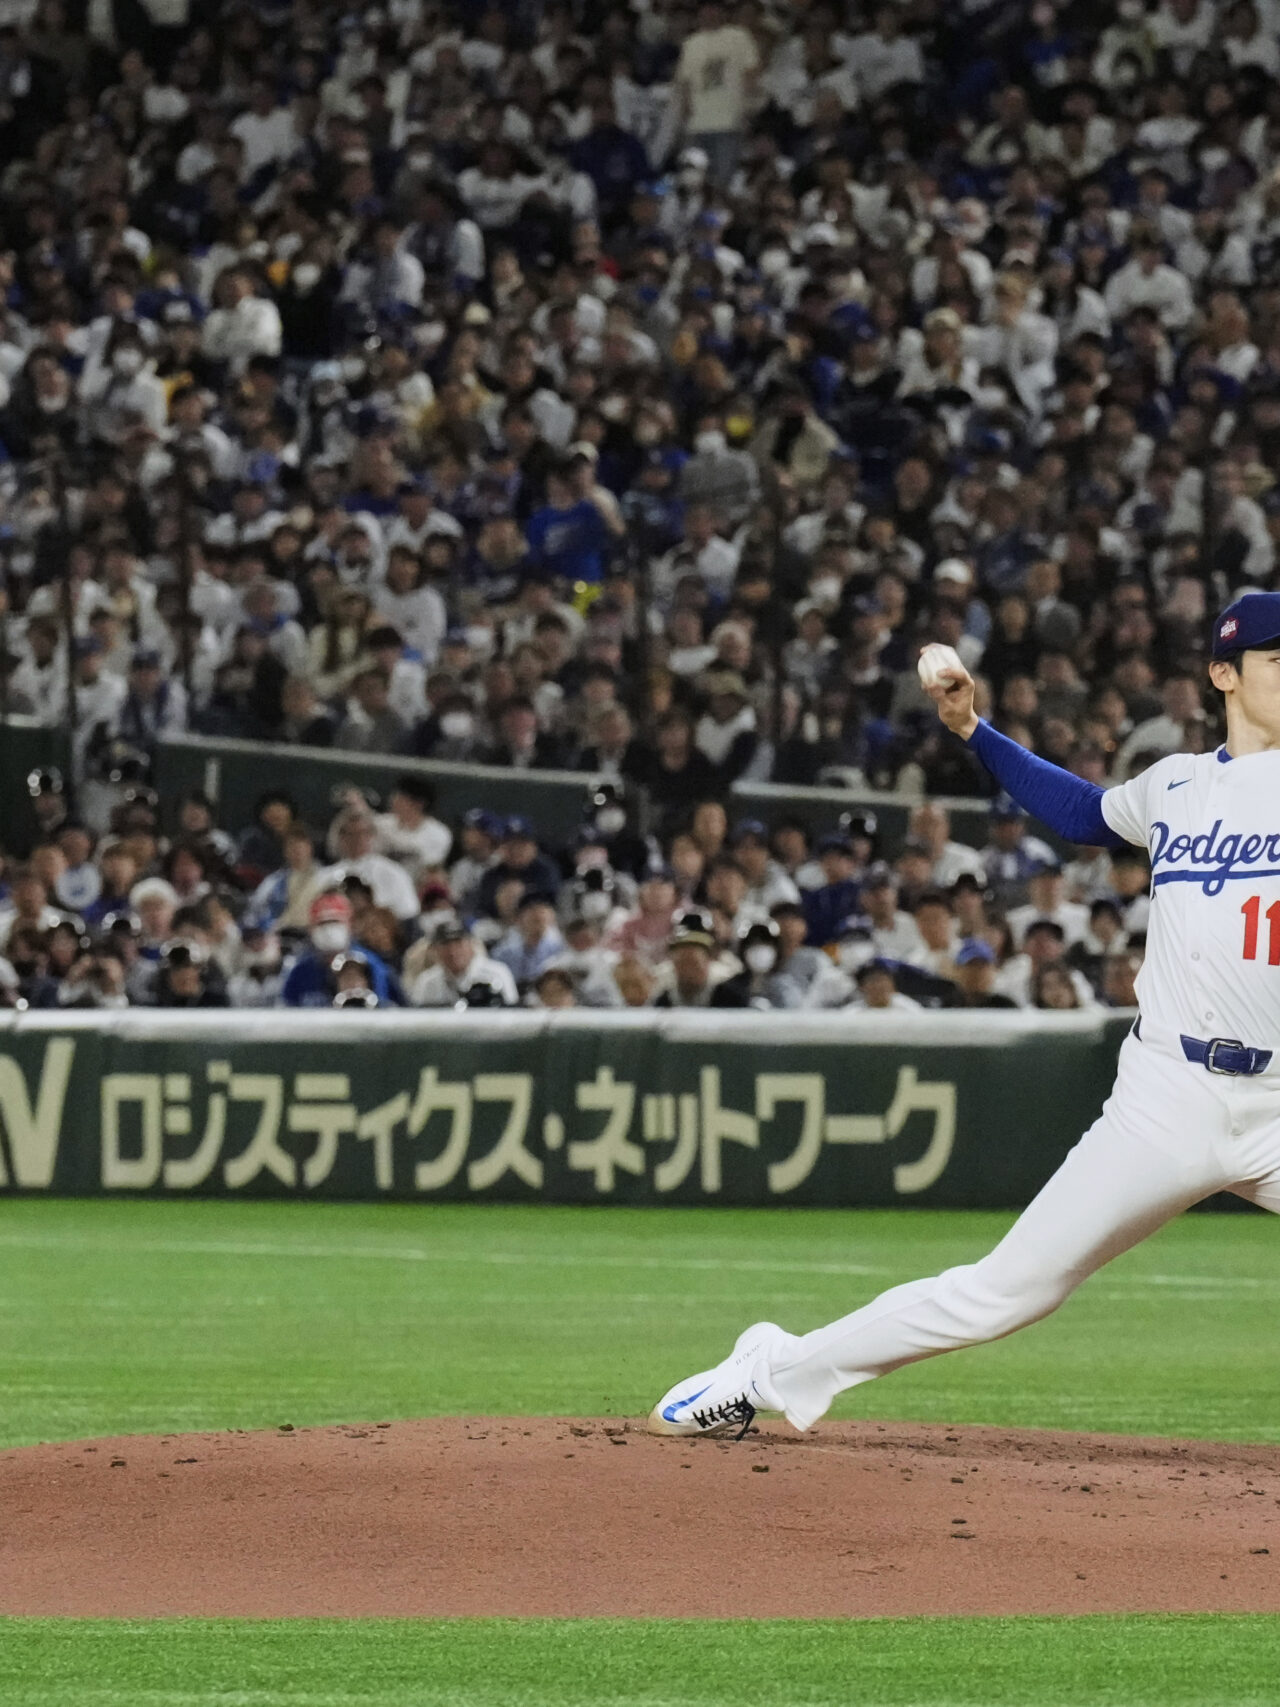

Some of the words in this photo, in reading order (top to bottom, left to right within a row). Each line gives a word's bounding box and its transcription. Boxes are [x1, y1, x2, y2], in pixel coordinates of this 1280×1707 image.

[102, 1060, 958, 1194] ロジスティクス・ネットワーク
